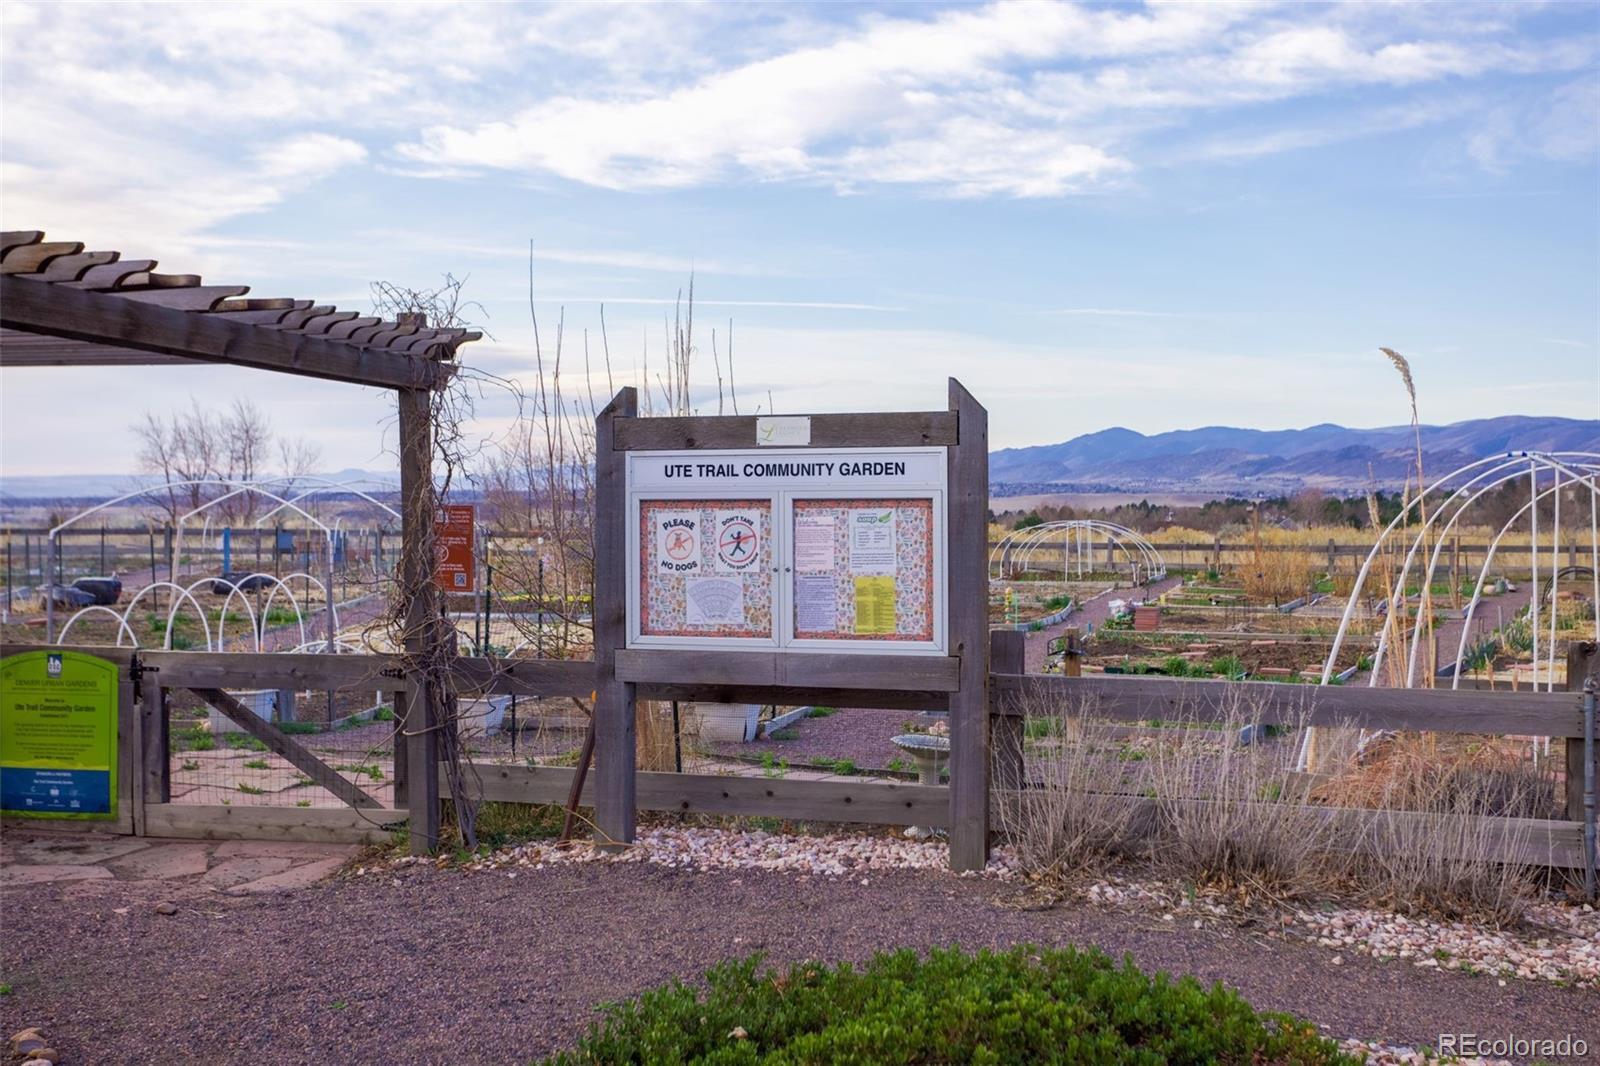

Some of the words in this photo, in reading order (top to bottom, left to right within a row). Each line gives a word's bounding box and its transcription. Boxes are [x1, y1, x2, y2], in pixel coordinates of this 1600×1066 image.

[664, 464, 693, 478] UTE
[696, 464, 739, 477] TRAIL
[743, 462, 835, 477] COMMUNITY
[839, 462, 906, 476] GARDEN
[662, 518, 696, 531] PLEASE
[661, 560, 674, 570] NO
[675, 560, 698, 571] DOGS
